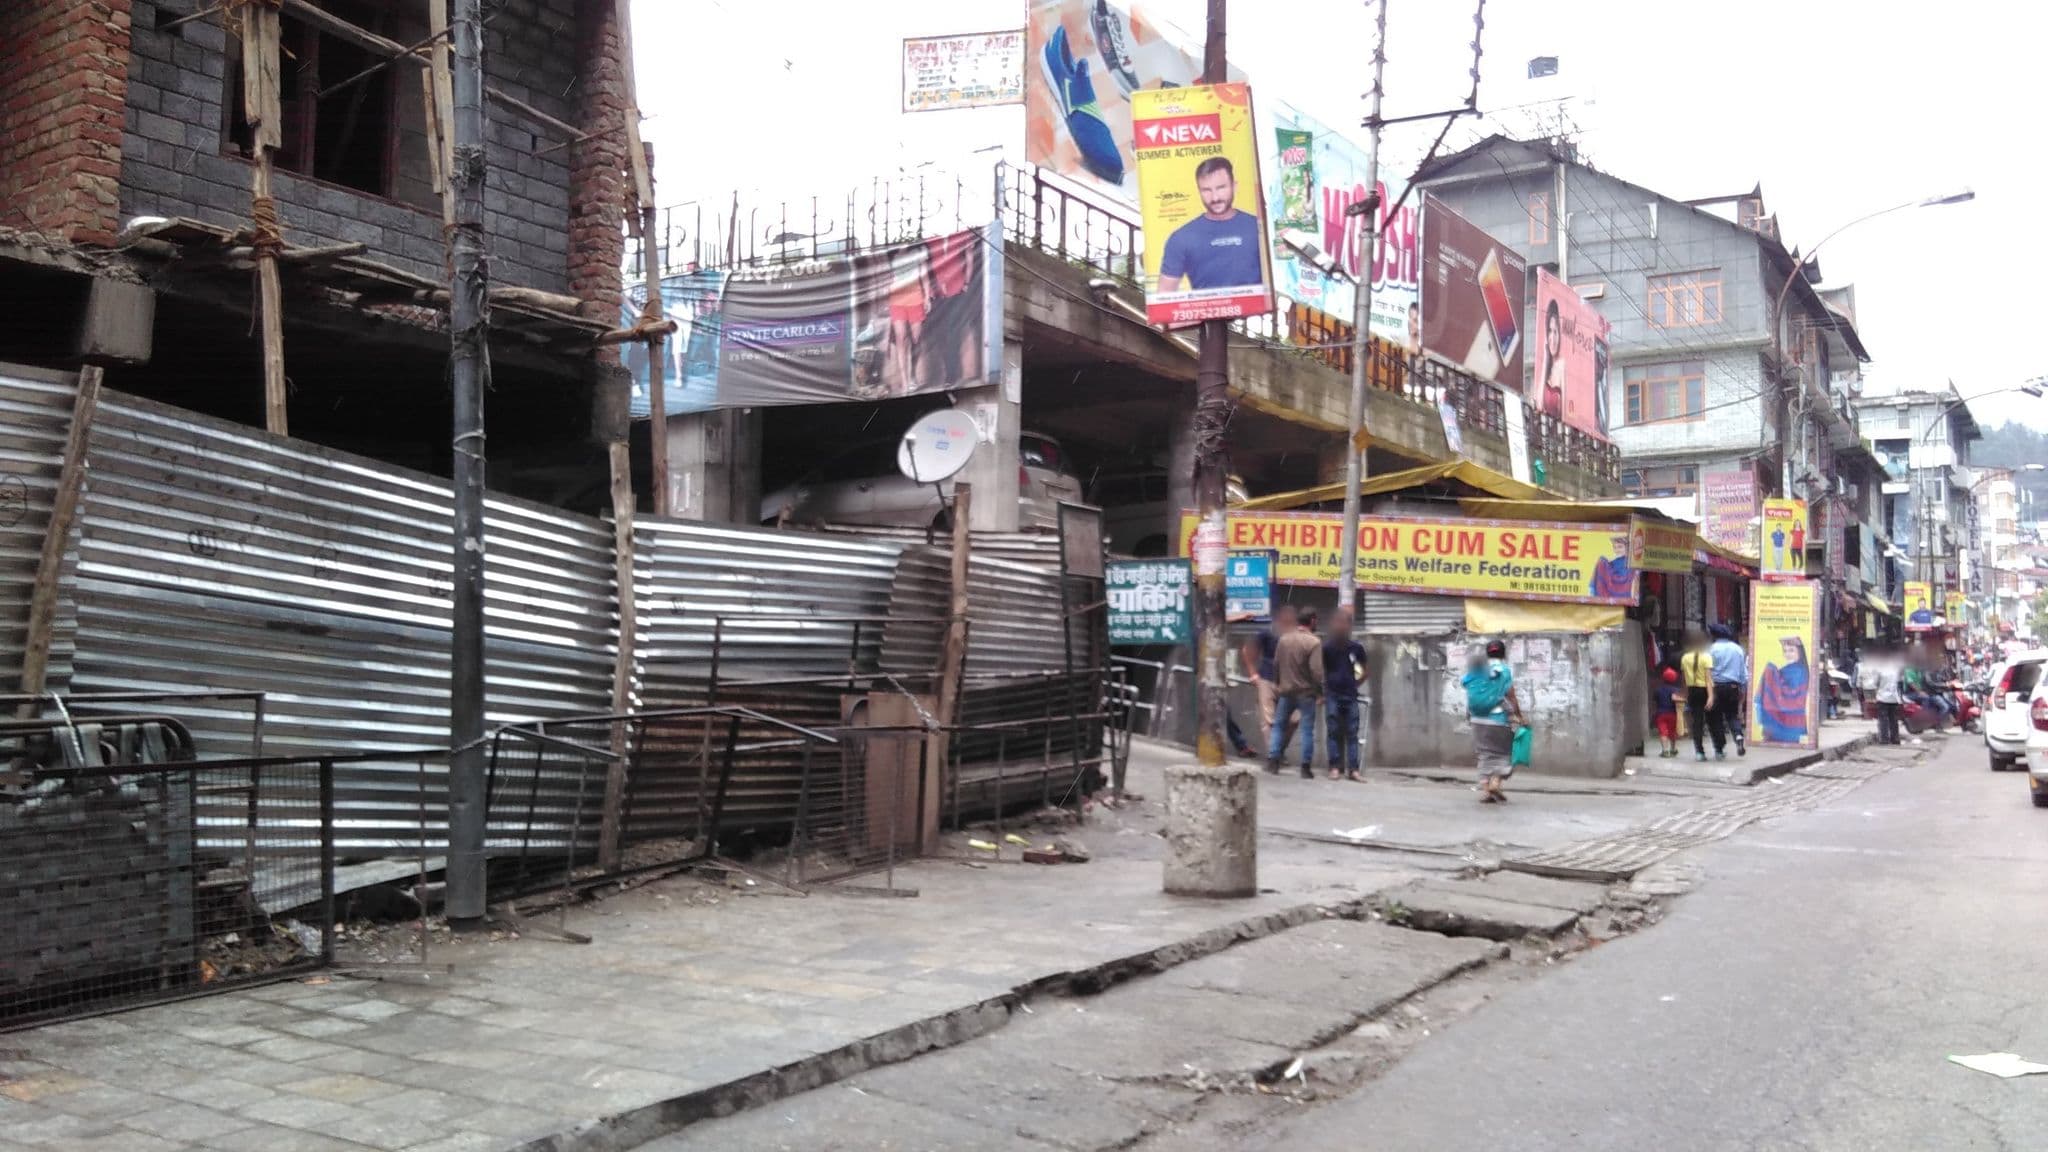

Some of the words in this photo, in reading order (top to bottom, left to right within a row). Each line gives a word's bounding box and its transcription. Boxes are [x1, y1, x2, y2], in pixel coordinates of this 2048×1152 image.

[1162, 123, 1216, 143] NEVA
[1136, 149, 1171, 161] SUMMER
[1174, 144, 1223, 158] ACTIVEWEAR
[727, 328, 770, 341] MONTE
[771, 324, 816, 339] CARLO
[1967, 494, 1980, 550] HOTEL
[1233, 522, 1400, 553] EXHIBITON
[1411, 529, 1485, 557] CUM
[1498, 532, 1581, 561] SALE
[1327, 552, 1399, 570] Asans
[1404, 556, 1472, 576] Welfare
[1477, 561, 1581, 581] Federation
[1970, 559, 1982, 592] YAK
[1226, 576, 1264, 588] ARKING
